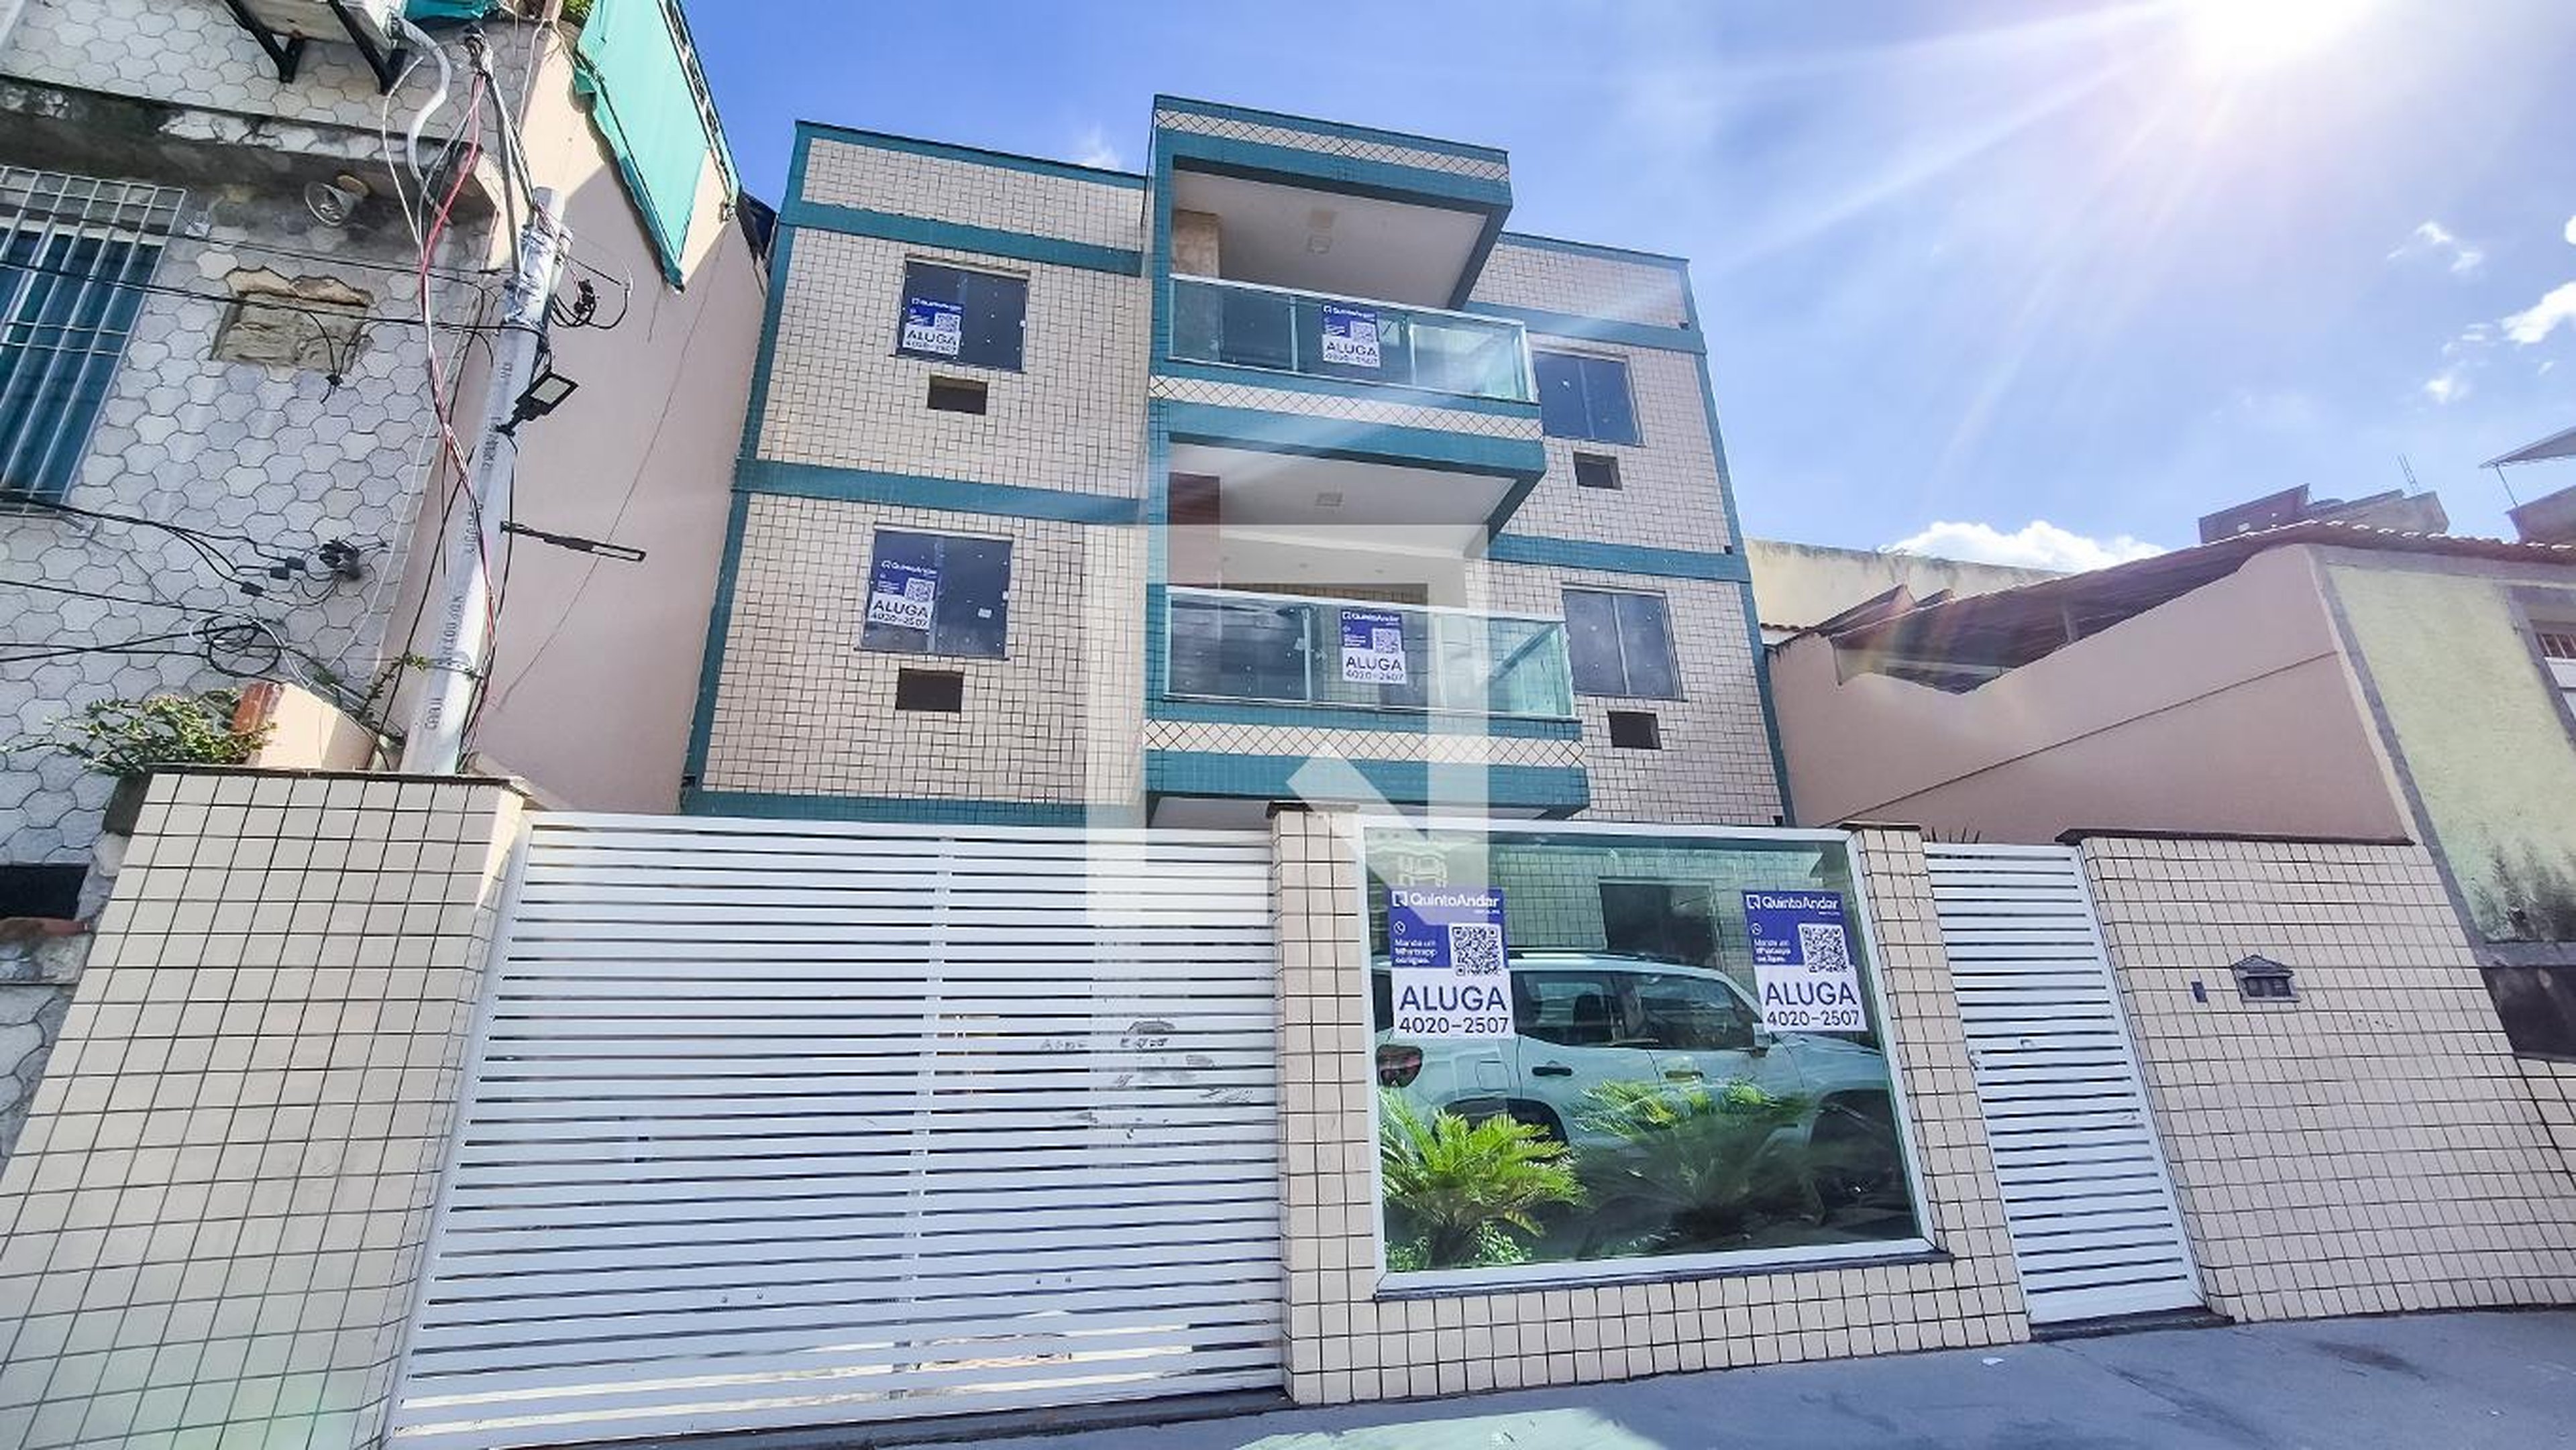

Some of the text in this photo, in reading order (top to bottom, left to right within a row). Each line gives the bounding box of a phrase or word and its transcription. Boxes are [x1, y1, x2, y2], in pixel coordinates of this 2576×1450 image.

[907, 330, 957, 346] ALUGA
[1326, 341, 1378, 357] ALUGA
[873, 599, 928, 618] ALUGA
[1346, 656, 1402, 671] ALUGA
[1410, 893, 1500, 908] QuintoAndar
[1762, 895, 1839, 909] QuintoAndar
[1399, 985, 1507, 1011] ALUGA
[1766, 982, 1858, 1006] ALUGA
[1399, 1017, 1509, 1034] 4020-2507
[1766, 1010, 1860, 1026] 4020-2507
